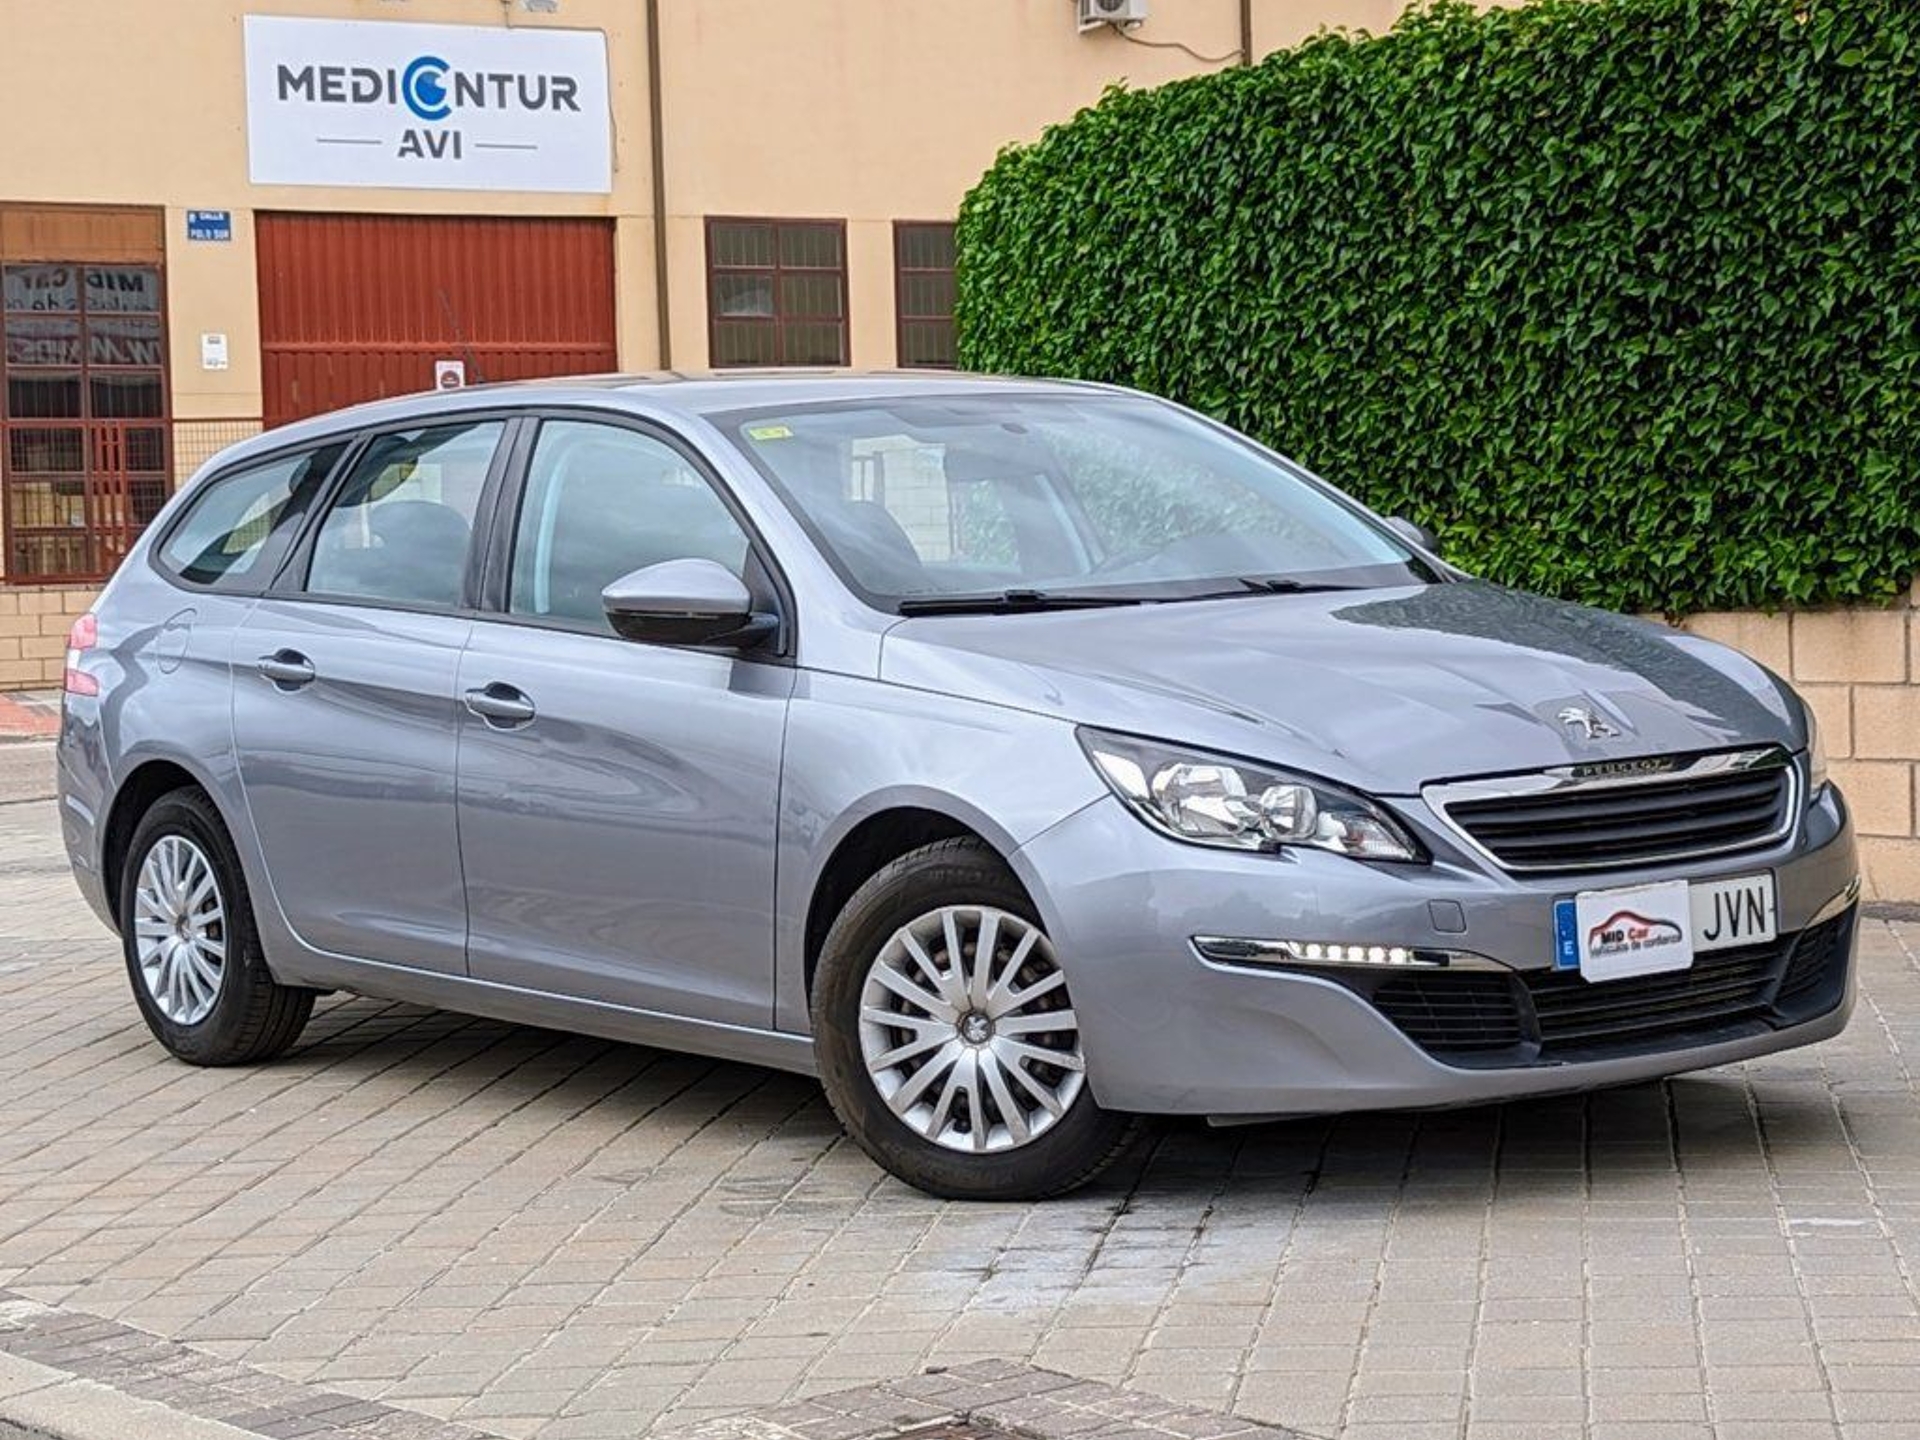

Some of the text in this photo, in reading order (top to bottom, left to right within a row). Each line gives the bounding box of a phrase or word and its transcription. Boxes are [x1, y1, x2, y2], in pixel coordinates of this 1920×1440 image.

[397, 129, 462, 159] AVI
[1703, 886, 1766, 941] JVN
[1601, 927, 1649, 943] MID Car
[1564, 940, 1574, 955] E
